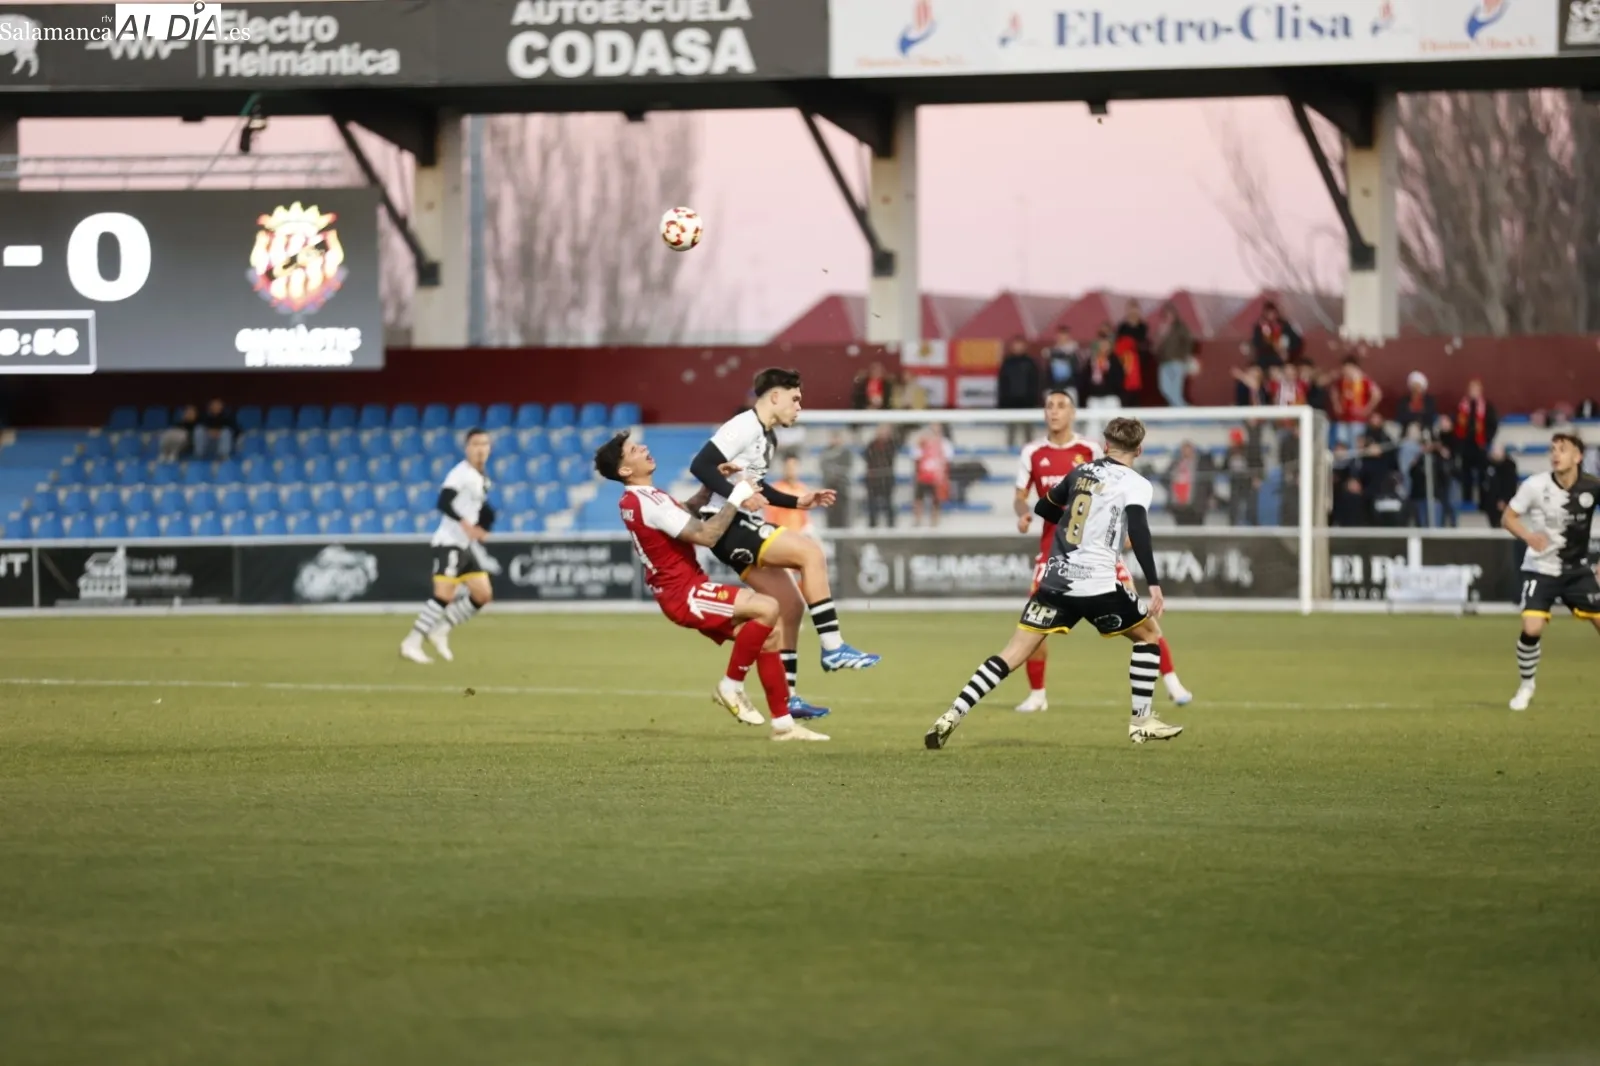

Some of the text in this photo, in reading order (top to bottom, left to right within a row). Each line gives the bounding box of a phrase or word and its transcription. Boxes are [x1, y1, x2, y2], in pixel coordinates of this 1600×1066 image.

[511, 0, 753, 25] AUTOESCUELA
[1055, 3, 1354, 47] Electro-Clisa
[213, 42, 401, 77] Helmántica
[508, 27, 757, 79] CODASA
[67, 211, 152, 302] 0
[1065, 493, 1093, 545] 8
[697, 582, 723, 598] 14
